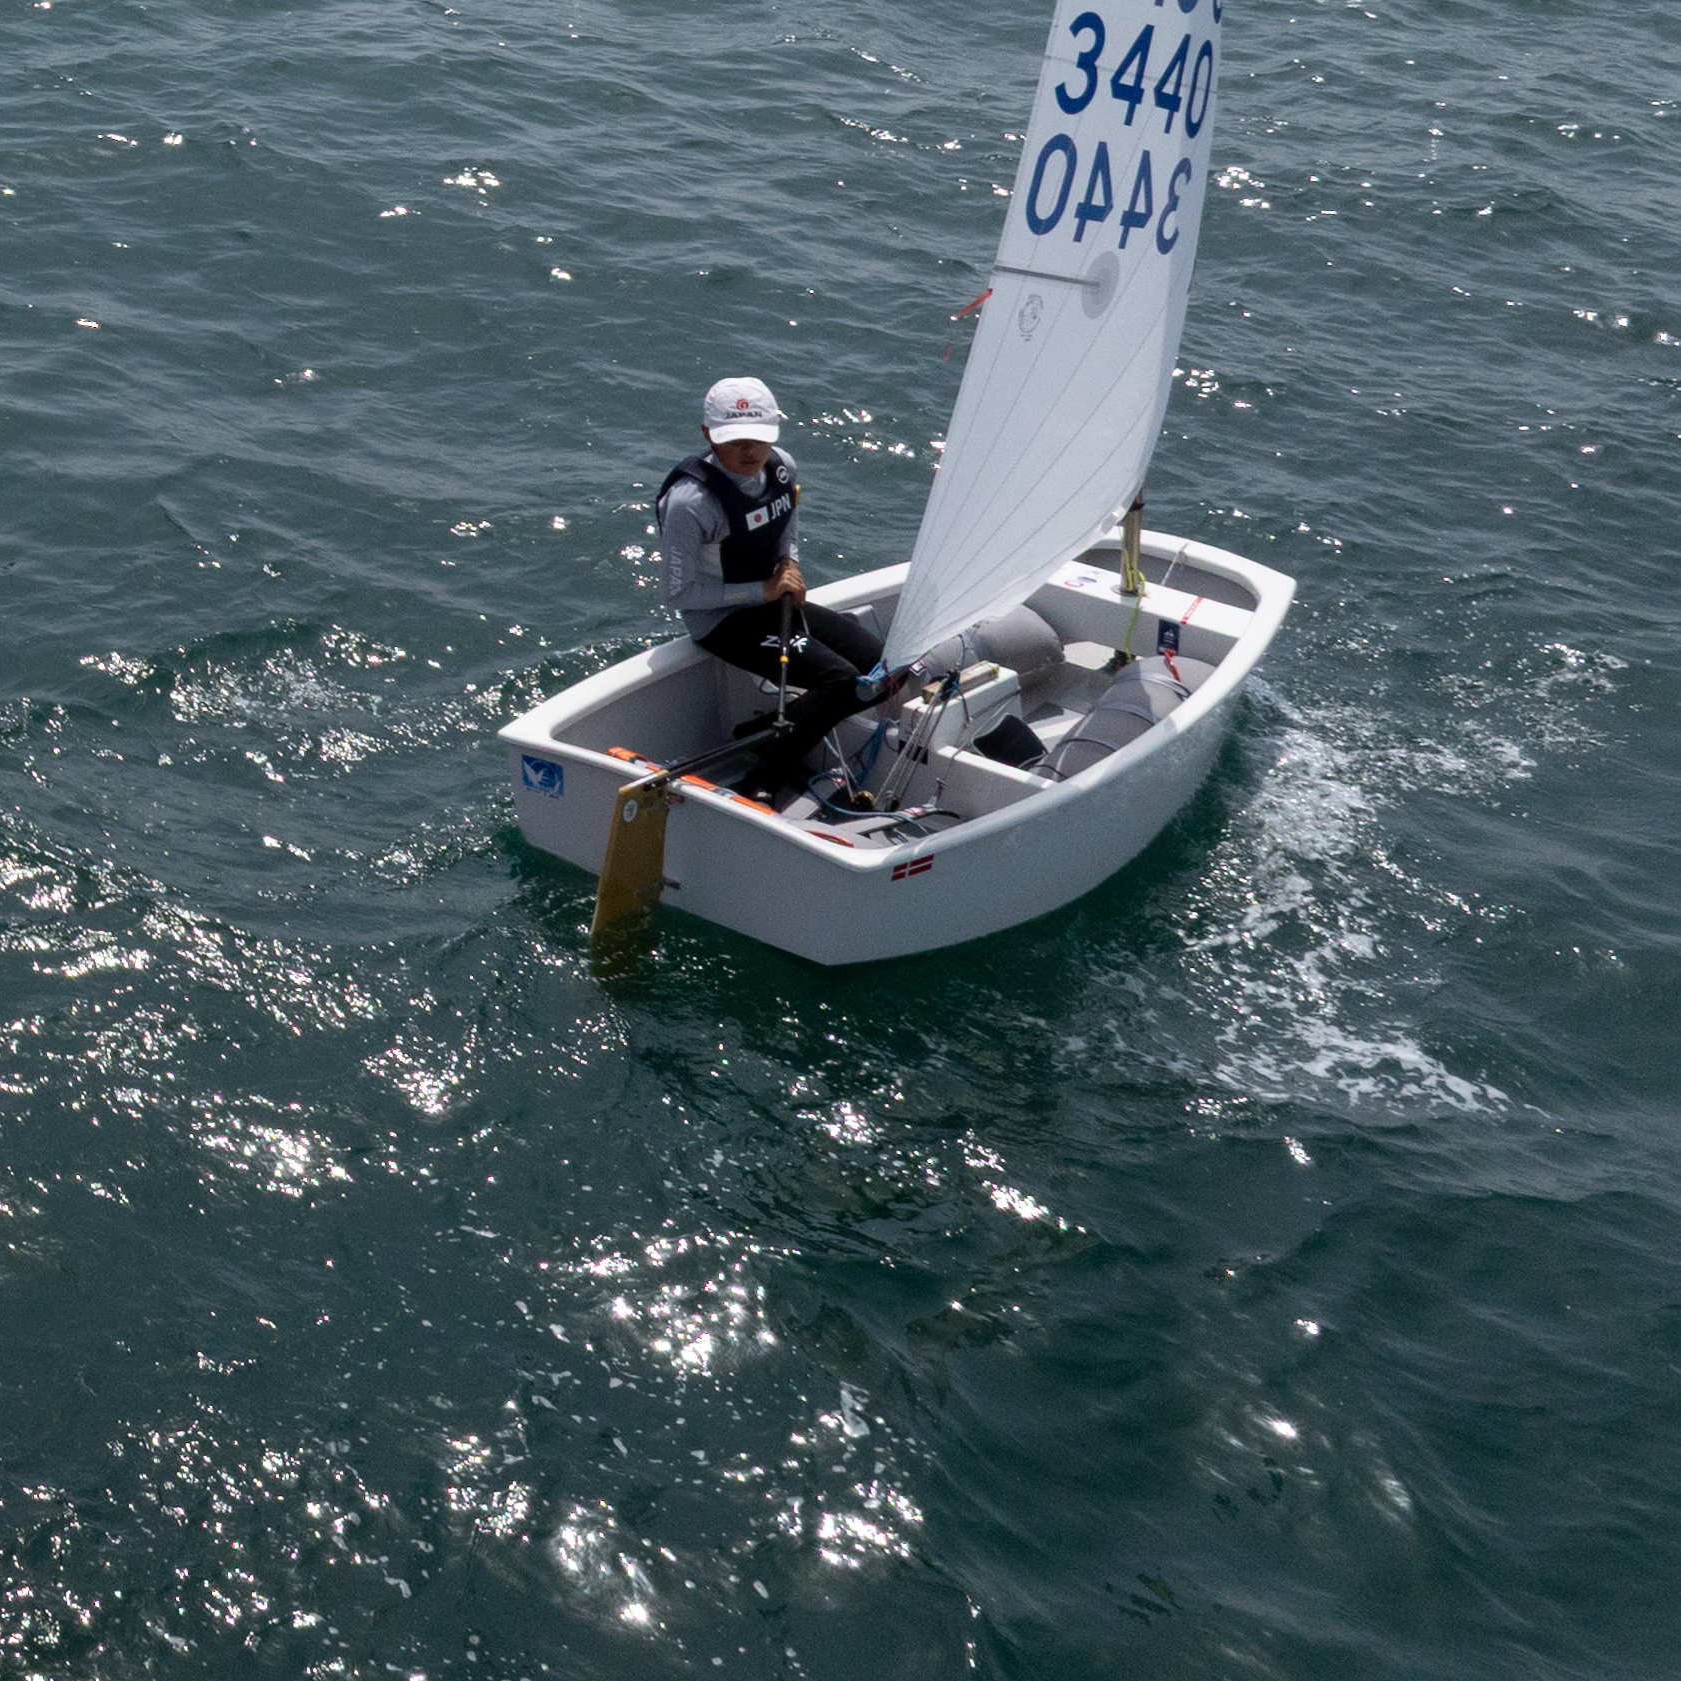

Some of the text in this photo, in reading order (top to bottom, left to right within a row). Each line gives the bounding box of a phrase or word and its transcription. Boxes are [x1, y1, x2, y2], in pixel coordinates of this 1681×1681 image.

[1055, 11, 1213, 139] 3440
[725, 411, 763, 419] JAPAN
[770, 492, 791, 520] JPN
[669, 545, 682, 596] JAPAN
